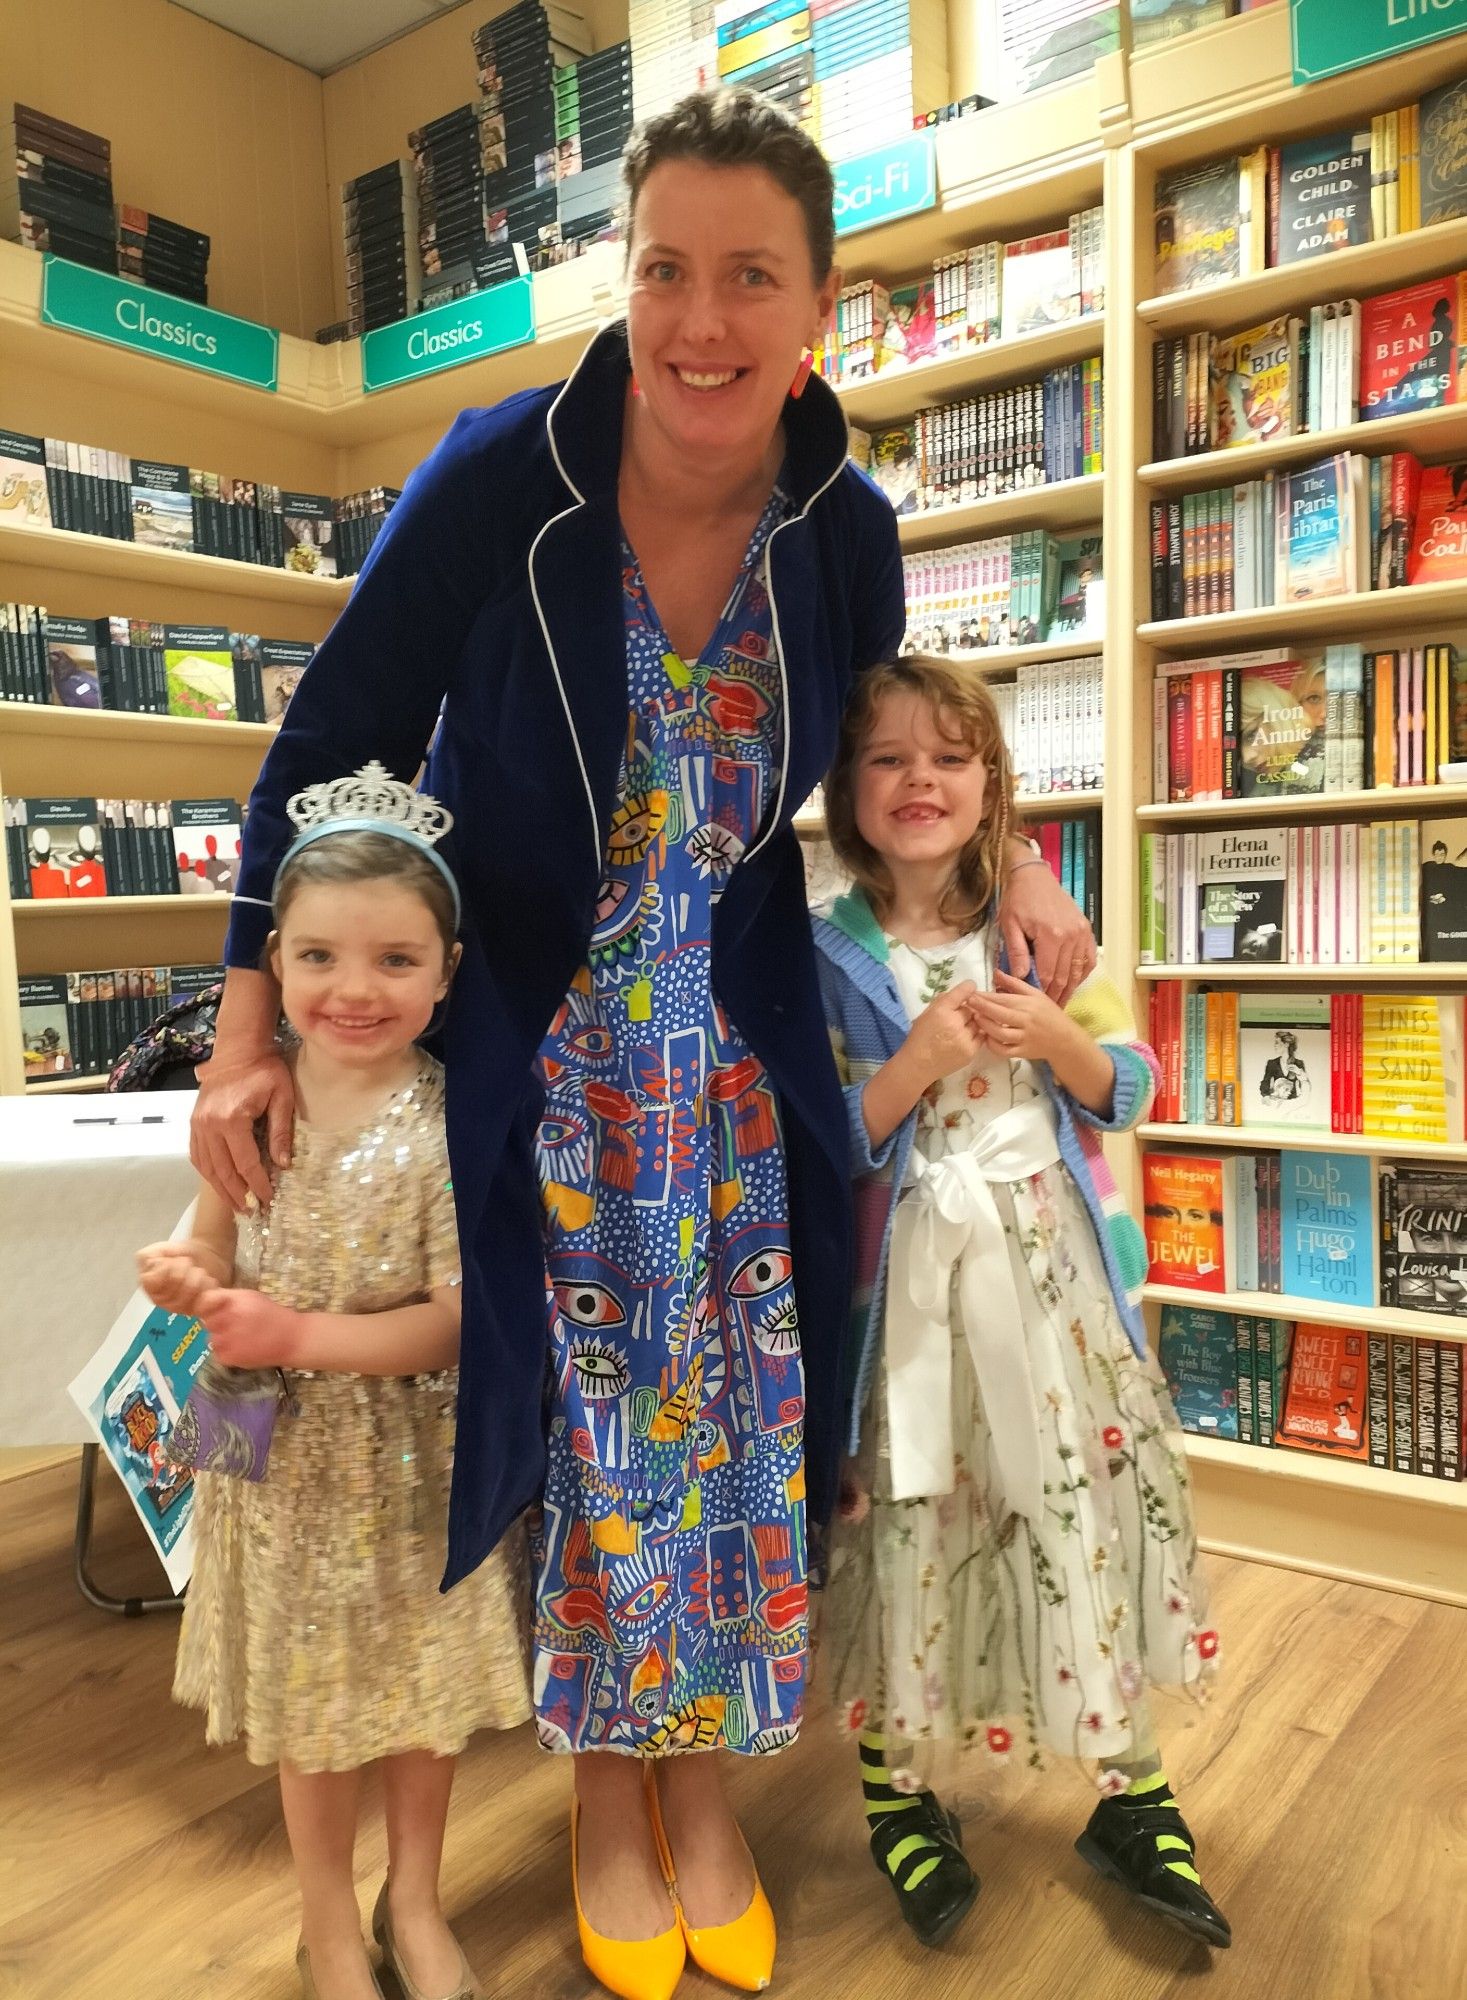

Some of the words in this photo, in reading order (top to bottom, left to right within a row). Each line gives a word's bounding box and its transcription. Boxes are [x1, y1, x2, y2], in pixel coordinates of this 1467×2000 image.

[1290, 155, 1364, 182] GOLDEN
[833, 162, 910, 217] Sci-Fi
[1298, 180, 1353, 202] CHILD
[1292, 205, 1356, 230] CLAIRE
[1296, 229, 1349, 252] ADAM
[115, 298, 218, 355] Classics
[1402, 312, 1417, 330] A
[407, 319, 483, 361] Classics
[1376, 331, 1444, 360] BEND
[1252, 346, 1290, 374] BIG
[1408, 357, 1438, 372] THE
[1382, 366, 1400, 378] IN
[1302, 478, 1326, 493] The
[1153, 505, 1163, 528] JOHN
[1170, 504, 1180, 526] JOHN
[1294, 493, 1336, 518] Paris
[1282, 516, 1342, 542] Library
[1153, 530, 1163, 568] BANVILLE
[1170, 528, 1180, 566] BANVILLE
[1226, 672, 1234, 732] CESARE
[1328, 692, 1340, 733] Betrayal
[1345, 691, 1358, 732] Betrayal
[1262, 704, 1304, 724] Iron
[1176, 702, 1185, 750] BETRAYALS
[1252, 724, 1312, 747] Annie
[1266, 754, 1298, 766] LUKE
[1222, 836, 1268, 853] Elena
[1209, 854, 1280, 870] Ferrante
[1209, 890, 1230, 902] The
[1231, 890, 1262, 904] Story
[1208, 913, 1240, 922] Name
[1380, 1008, 1430, 1033] LINES
[1384, 1038, 1399, 1050] IN
[1404, 1038, 1424, 1052] THE
[1378, 1056, 1432, 1082] SAND
[1224, 1084, 1232, 1099] Anne
[1150, 1166, 1172, 1178] Neil
[1174, 1168, 1216, 1184] Hegarty
[1296, 1199, 1358, 1226] Palms
[1172, 1230, 1195, 1243] THE
[1297, 1230, 1356, 1254] Hugo
[1399, 1256, 1450, 1276] Louisa
[1322, 1276, 1357, 1296] ton
[1190, 1321, 1216, 1330] JONES
[172, 1322, 202, 1364] SEARCH
[1181, 1344, 1199, 1357] The
[1202, 1346, 1222, 1360] Boy
[1299, 1335, 1340, 1356] SWEET
[1176, 1359, 1198, 1370] with
[1201, 1360, 1222, 1374] Blue
[1295, 1354, 1338, 1372] SWEET
[1418, 1348, 1436, 1382] HITMAN
[1176, 1370, 1220, 1386] Trousers
[1292, 1369, 1334, 1390] REVENGE
[1370, 1368, 1386, 1392] SAVED
[1394, 1372, 1412, 1396] SAVED
[1371, 1398, 1387, 1418] KING
[1418, 1382, 1436, 1414] ANDERS
[1287, 1415, 1328, 1427] JONAS
[1396, 1402, 1412, 1422] KING
[1286, 1422, 1328, 1436] JONASSON
[1371, 1421, 1388, 1454] SWEDEN
[1396, 1426, 1412, 1458] SWEDEN
